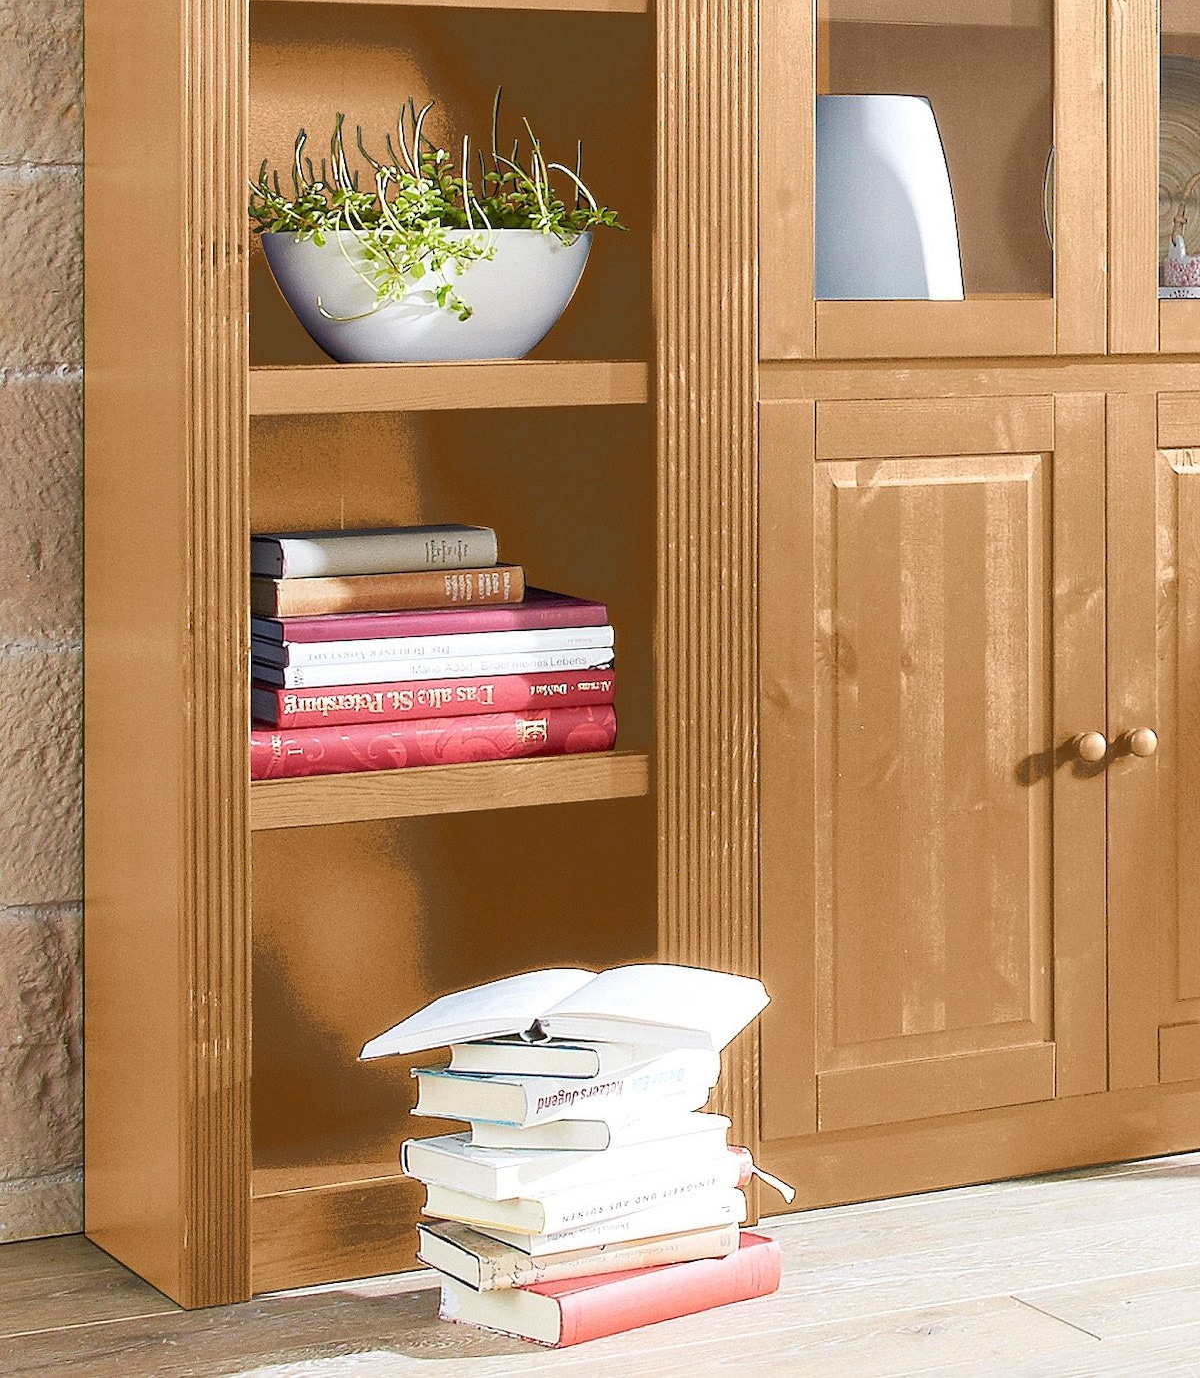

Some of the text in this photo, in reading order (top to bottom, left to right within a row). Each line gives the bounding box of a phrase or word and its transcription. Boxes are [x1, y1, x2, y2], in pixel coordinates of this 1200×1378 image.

[550, 655, 588, 667] Lebens
[284, 684, 495, 717] Das alte St. Petersburg
[580, 1080, 624, 1100] Ketzers
[535, 1089, 579, 1115] Jugend
[609, 1200, 630, 1211] AUS
[635, 1192, 657, 1204] UND
